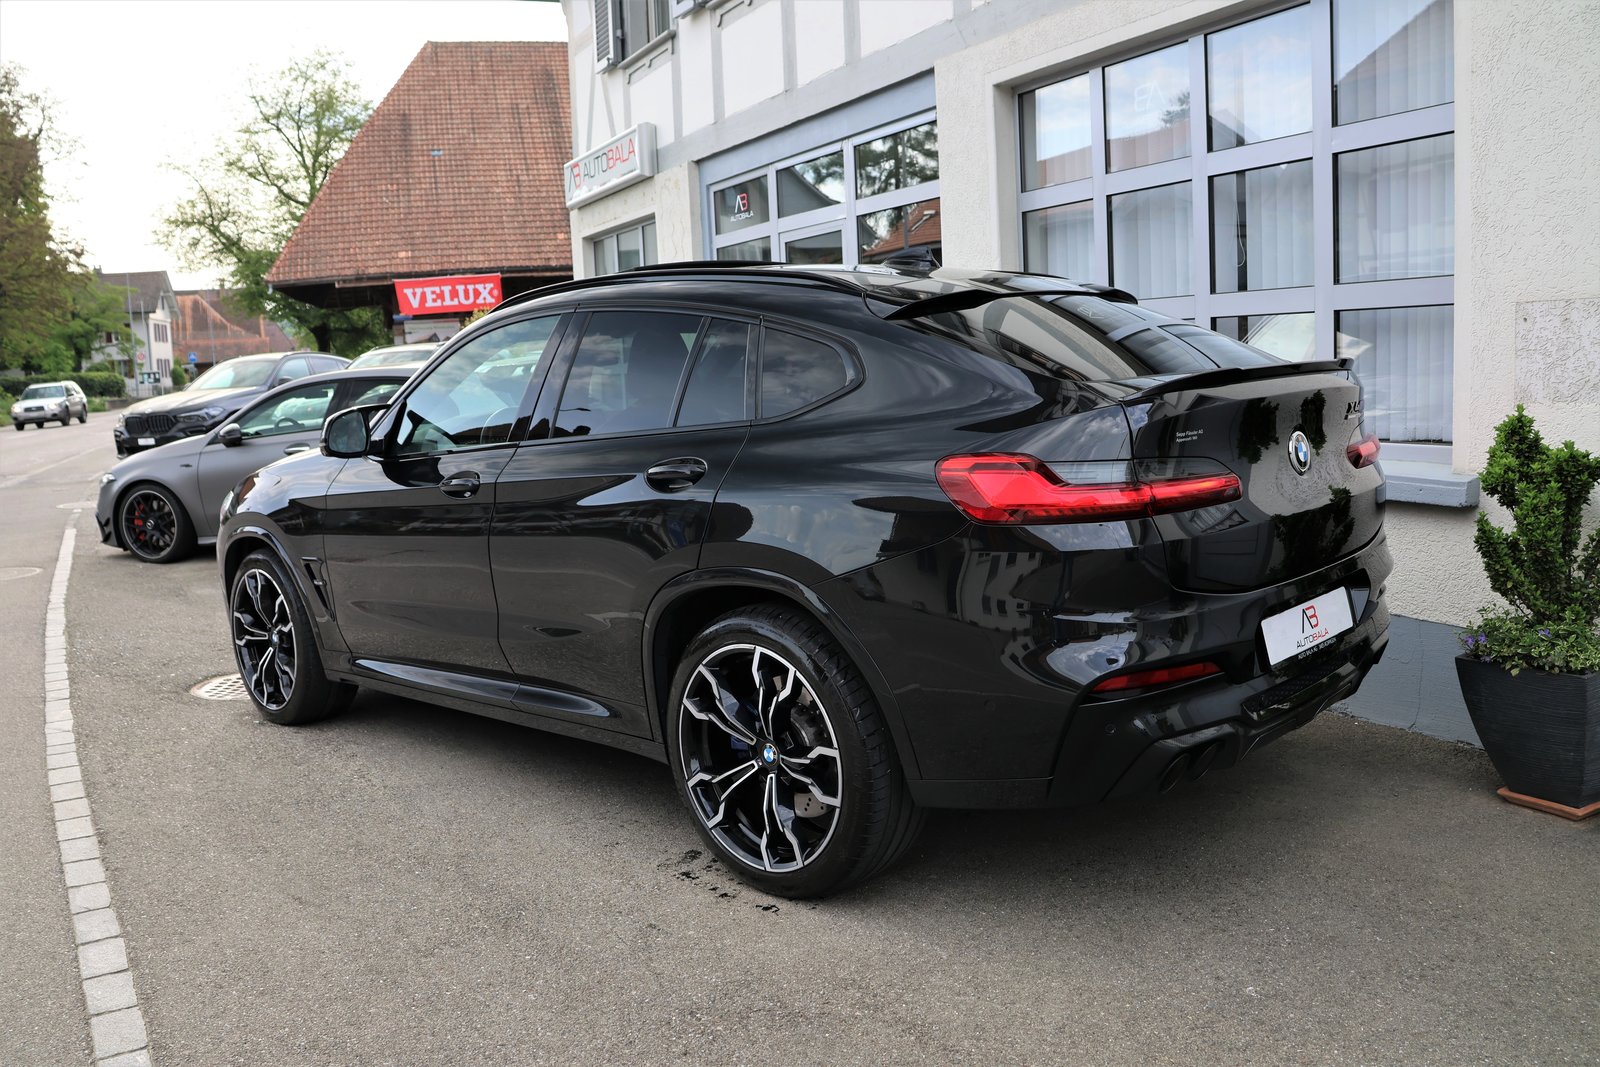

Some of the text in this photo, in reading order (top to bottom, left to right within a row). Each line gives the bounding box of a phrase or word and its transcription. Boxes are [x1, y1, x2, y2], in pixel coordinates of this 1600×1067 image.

[583, 138, 636, 179] AUTOBALA
[730, 210, 754, 222] AUTOBALA
[403, 283, 495, 309] VELUX
[1296, 628, 1329, 648] AUTOBALA
